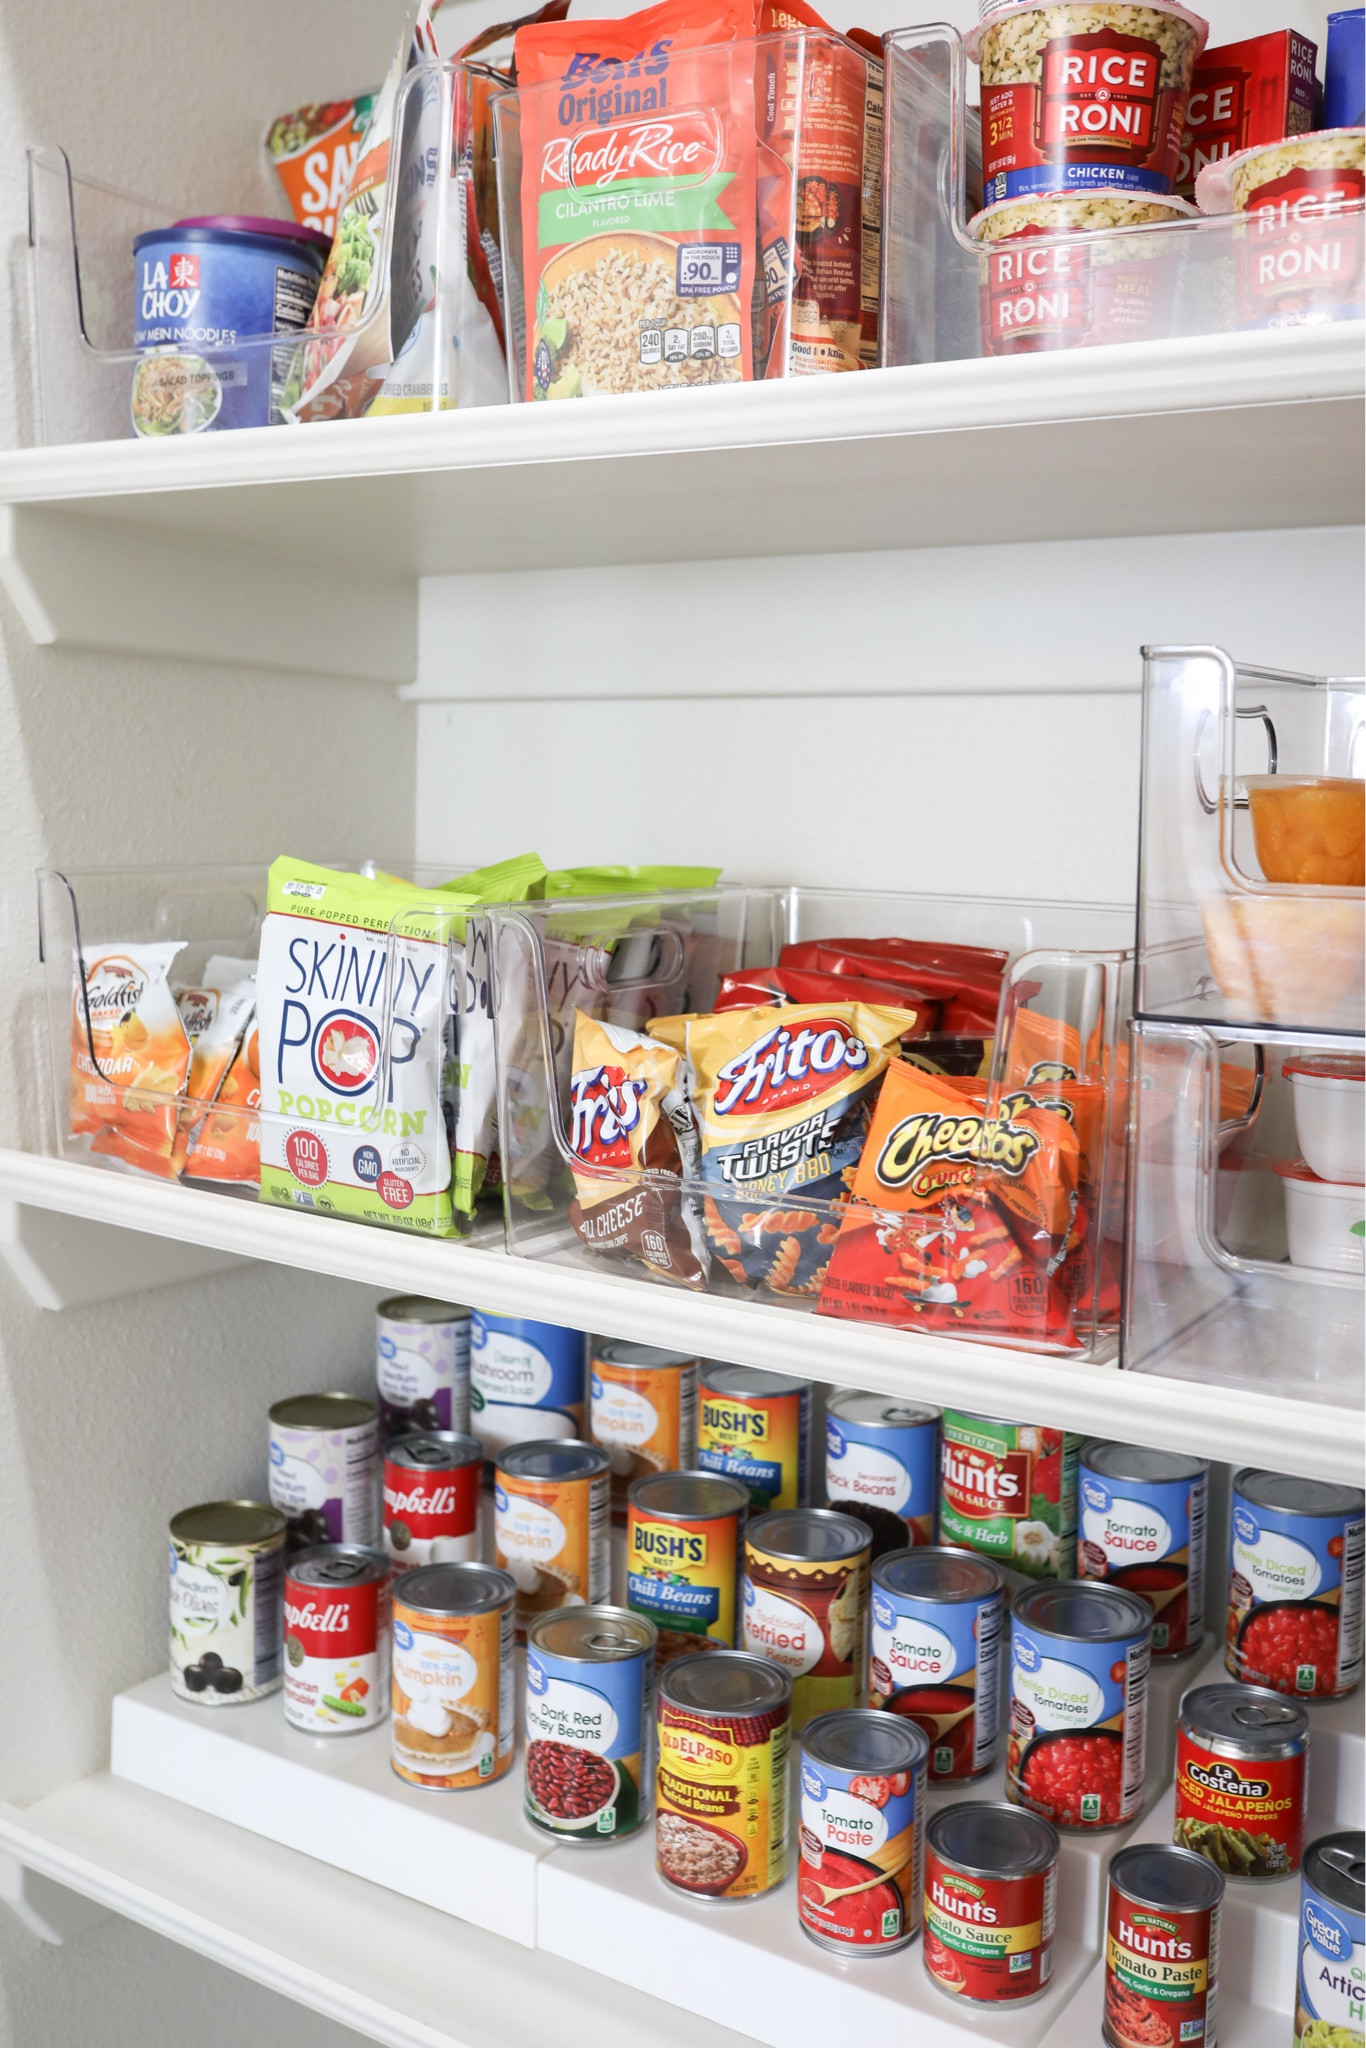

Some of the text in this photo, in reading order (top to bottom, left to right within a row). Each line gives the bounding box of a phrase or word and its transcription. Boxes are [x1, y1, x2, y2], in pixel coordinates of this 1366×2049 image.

[1291, 38, 1313, 64] RICE
[1062, 55, 1148, 88] RICE
[1290, 59, 1313, 84] RONI
[558, 78, 667, 126] Original
[766, 72, 776, 123] Cool Touch
[1000, 90, 1014, 101] ADD
[1295, 87, 1306, 97] BEEF
[990, 101, 1008, 113] WATER
[1184, 86, 1234, 126] CE
[1059, 103, 1142, 135] RONI
[998, 129, 1014, 142] MIN
[1067, 167, 1125, 180] CHICKEN
[1079, 179, 1124, 189] broth and herbs
[556, 191, 676, 220] CILANTRO LIME
[1258, 190, 1345, 235] RICE
[592, 215, 631, 229] FLAVORED
[172, 256, 199, 288] 東
[999, 246, 1072, 283] RICE
[1259, 241, 1342, 285] RONI
[143, 260, 168, 291] LA
[680, 284, 737, 294] BPA FREE POUCH
[1116, 282, 1151, 296] MEAL
[142, 288, 201, 321] CHOY
[1000, 291, 1070, 328] RONI
[147, 327, 238, 345] MEIN NOODLES
[642, 333, 660, 348] 240
[791, 342, 812, 355] Good
[159, 370, 235, 388] SALAD TOPPINGS
[290, 904, 315, 916] PURE
[319, 908, 359, 924] POPPED
[285, 932, 436, 1016] SKINNY
[277, 998, 422, 1103] POP
[713, 1024, 869, 1116] Fritos
[761, 1083, 811, 1105] BRAND
[277, 1089, 428, 1138] POPCORN
[742, 1111, 827, 1159] FLAVOR
[294, 1136, 319, 1161] 100
[362, 1150, 374, 1161] NON
[400, 1148, 410, 1157] NO
[717, 1118, 843, 1183] TWISTS
[876, 1113, 1039, 1186] Cheetos
[295, 1157, 320, 1173] CALORIES
[357, 1157, 378, 1178] GMO
[391, 1156, 422, 1166] ARTIFICIAL
[792, 1152, 832, 1185] BBQ
[298, 1166, 320, 1182] PER BAG
[383, 1177, 405, 1190] GLUTEN
[382, 1185, 411, 1204] FREE
[363, 1209, 436, 1231] NET WT OZ (18g)
[597, 1191, 648, 1238] CHEESE
[644, 1233, 663, 1252] 160
[1013, 1276, 1045, 1296] 160
[702, 1403, 766, 1438] BUSH'S
[718, 1431, 738, 1442] BEST
[946, 1429, 997, 1452] PREMIUM
[725, 1457, 776, 1480] Beans
[852, 1479, 897, 1497] Beans
[965, 1493, 1007, 1513] SAUCE
[963, 1525, 1009, 1546] & Herb
[1105, 1519, 1158, 1538] Tomato
[634, 1525, 704, 1563] BUSH'S
[1103, 1530, 1158, 1553] Sauce
[652, 1556, 675, 1567] BEST
[1265, 1559, 1307, 1577] Diced
[1251, 1564, 1306, 1587] Tomatoes
[628, 1575, 714, 1606] Chili Beans
[662, 1603, 699, 1614] BEANS
[765, 1646, 805, 1668] Beans
[890, 1636, 943, 1659] Tomato
[395, 1656, 463, 1689] Pumpkin
[419, 1658, 440, 1671] 100%
[888, 1648, 942, 1675] Sauce
[1017, 1673, 1090, 1705] Petite Diced
[540, 1702, 603, 1728] Dark Red
[1032, 1692, 1089, 1715] Tomatoes
[557, 1721, 602, 1741] Beans
[1189, 1764, 1263, 1797] Costeña
[1215, 1765, 1233, 1780] La
[660, 1767, 734, 1803] TRADITIONAL
[663, 1786, 726, 1815] Refried Beans
[1202, 1802, 1243, 1820] JALAPEÑO
[1243, 1813, 1279, 1821] PEPPERS
[1207, 1793, 1293, 1814] JALAPEÑOS
[820, 1807, 874, 1831] Tomato
[826, 1823, 874, 1847] Paste
[955, 1880, 982, 1897] NATURAL
[1132, 1914, 1177, 1933] 100% NATURAL
[1305, 1906, 1342, 1947] Great
[942, 1932, 1000, 1956] Garlic & Oregano
[965, 1926, 1013, 1945] Sauce
[1310, 1926, 1342, 1956] Value
[1109, 1939, 1204, 1982] Tomato Paste
[1117, 1970, 1191, 1998] Basil, Garlic & Oregano
